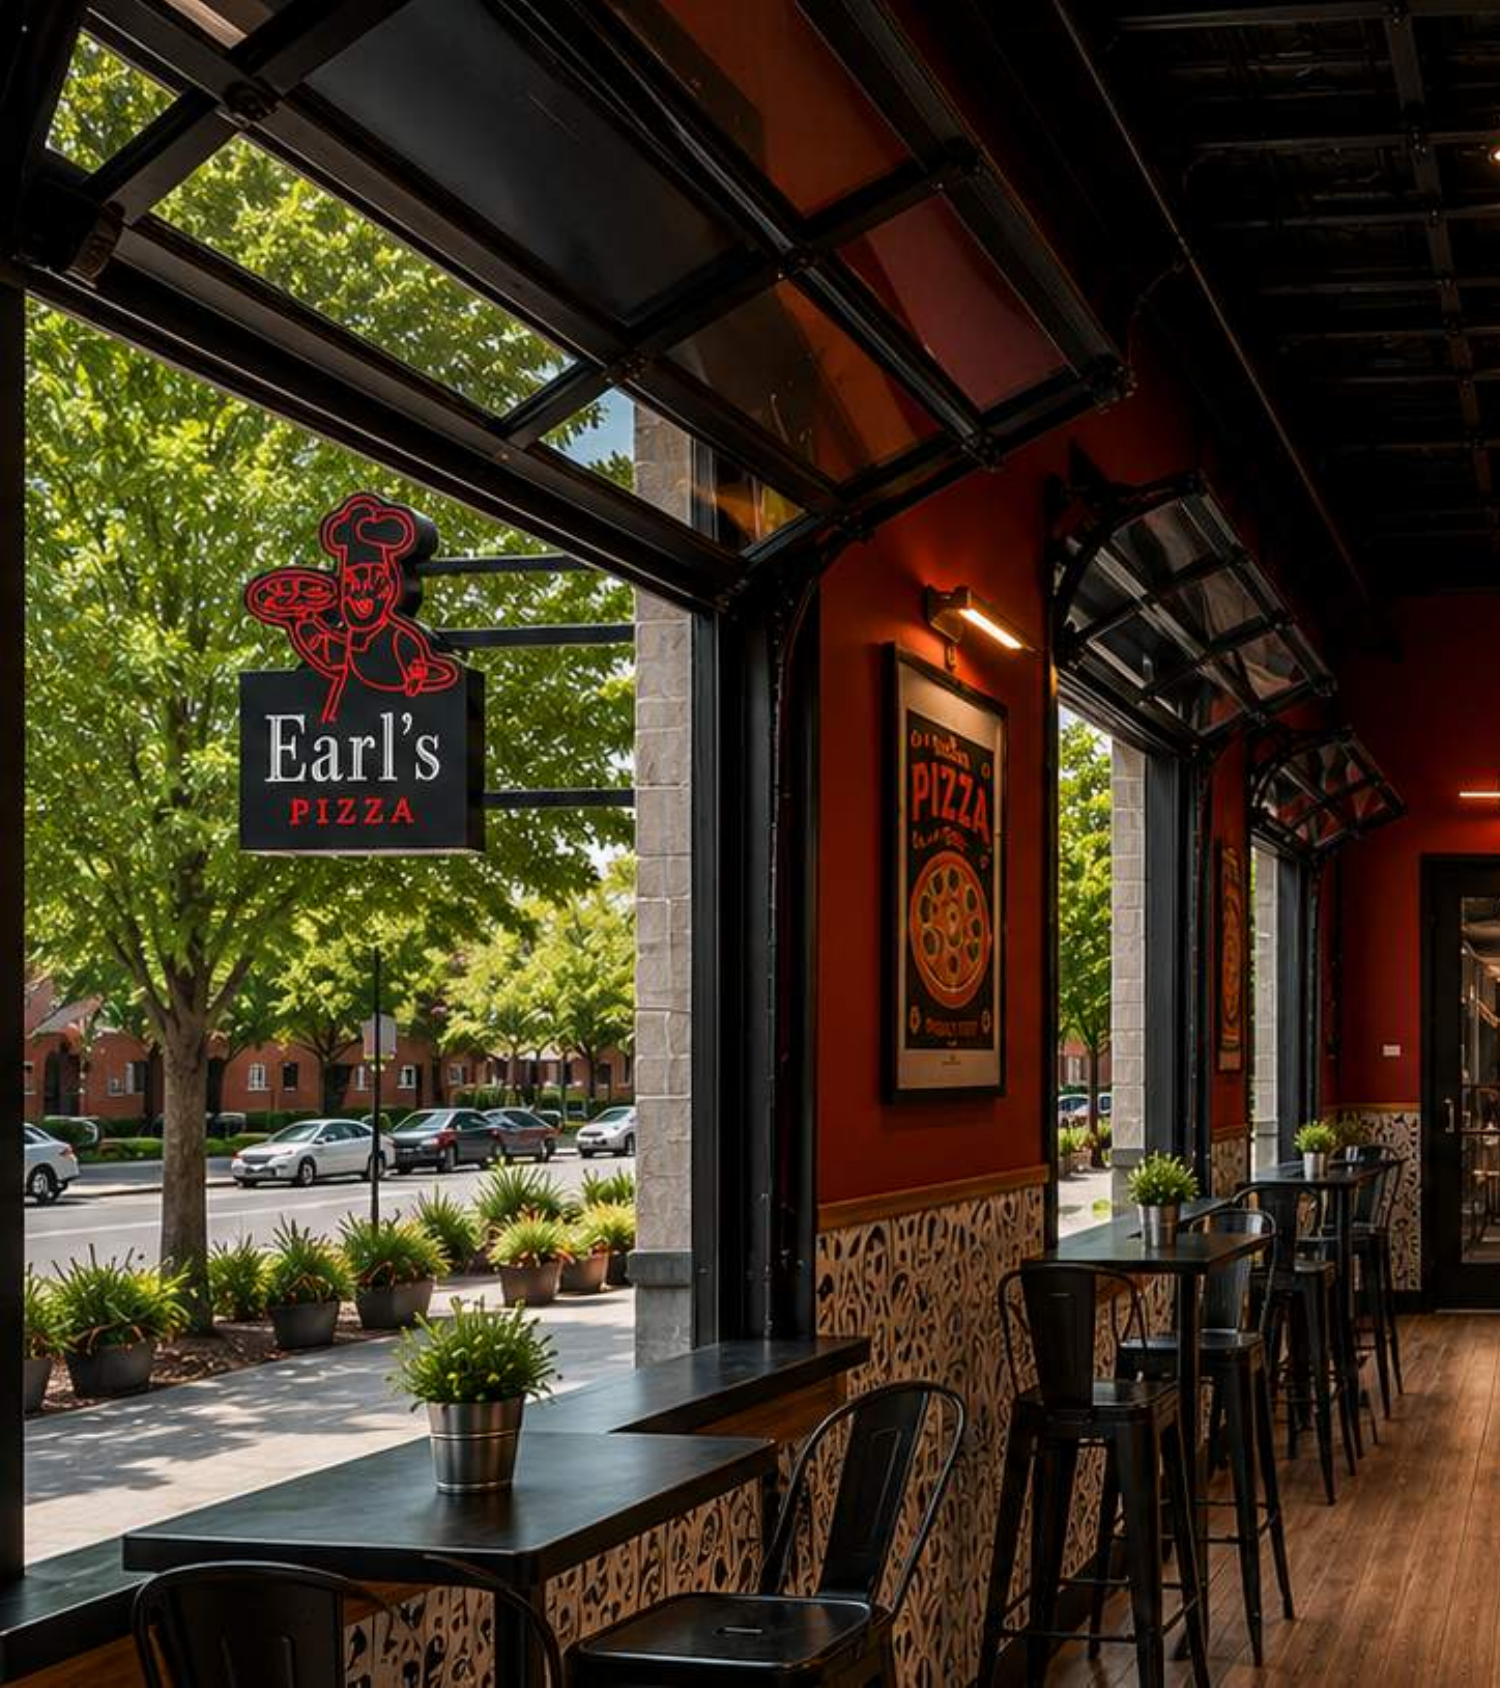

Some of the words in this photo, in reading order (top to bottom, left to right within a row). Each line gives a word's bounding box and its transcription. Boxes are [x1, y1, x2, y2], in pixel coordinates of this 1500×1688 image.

[264, 711, 441, 783] Earl's
[289, 798, 414, 826] PIZZA
[912, 761, 991, 846] PIZZA
